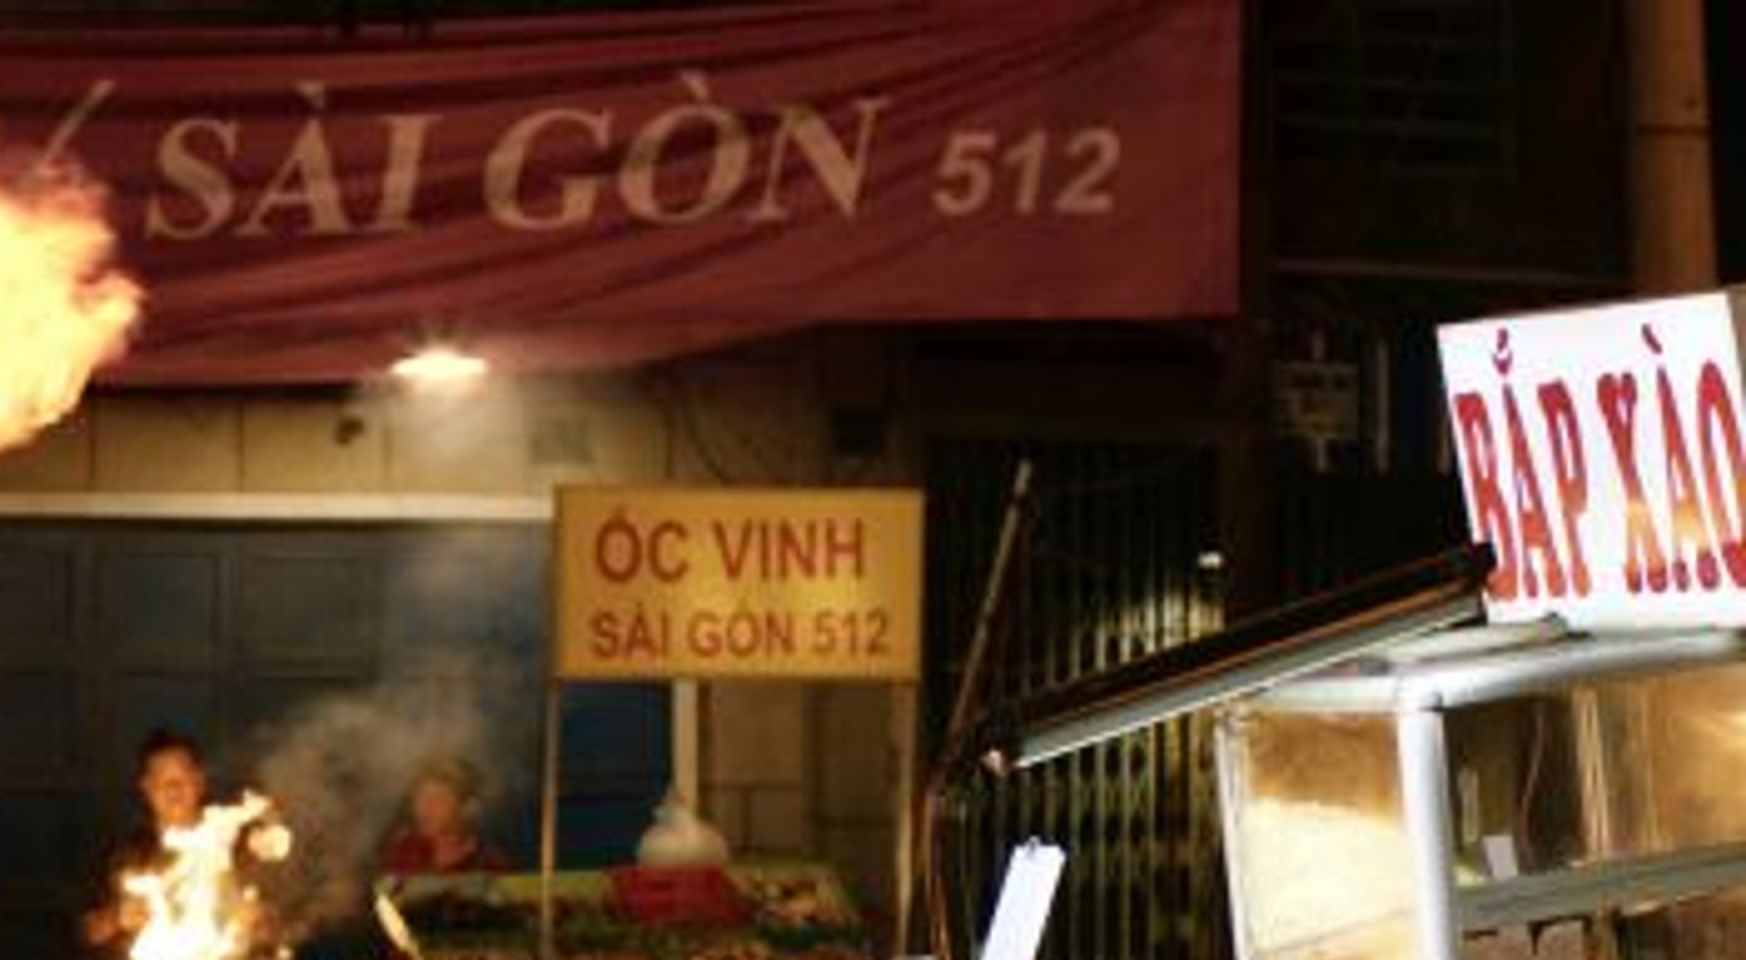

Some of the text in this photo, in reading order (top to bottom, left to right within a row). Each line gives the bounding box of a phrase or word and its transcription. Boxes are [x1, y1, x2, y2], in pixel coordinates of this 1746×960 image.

[143, 80, 444, 241] SÀI
[482, 70, 892, 231] GÒN
[933, 128, 1121, 217] 512
[1454, 322, 1746, 602] BẮP XÀO
[595, 506, 865, 583] ỐC VINH
[589, 600, 890, 659] SÀI GÒN 512
